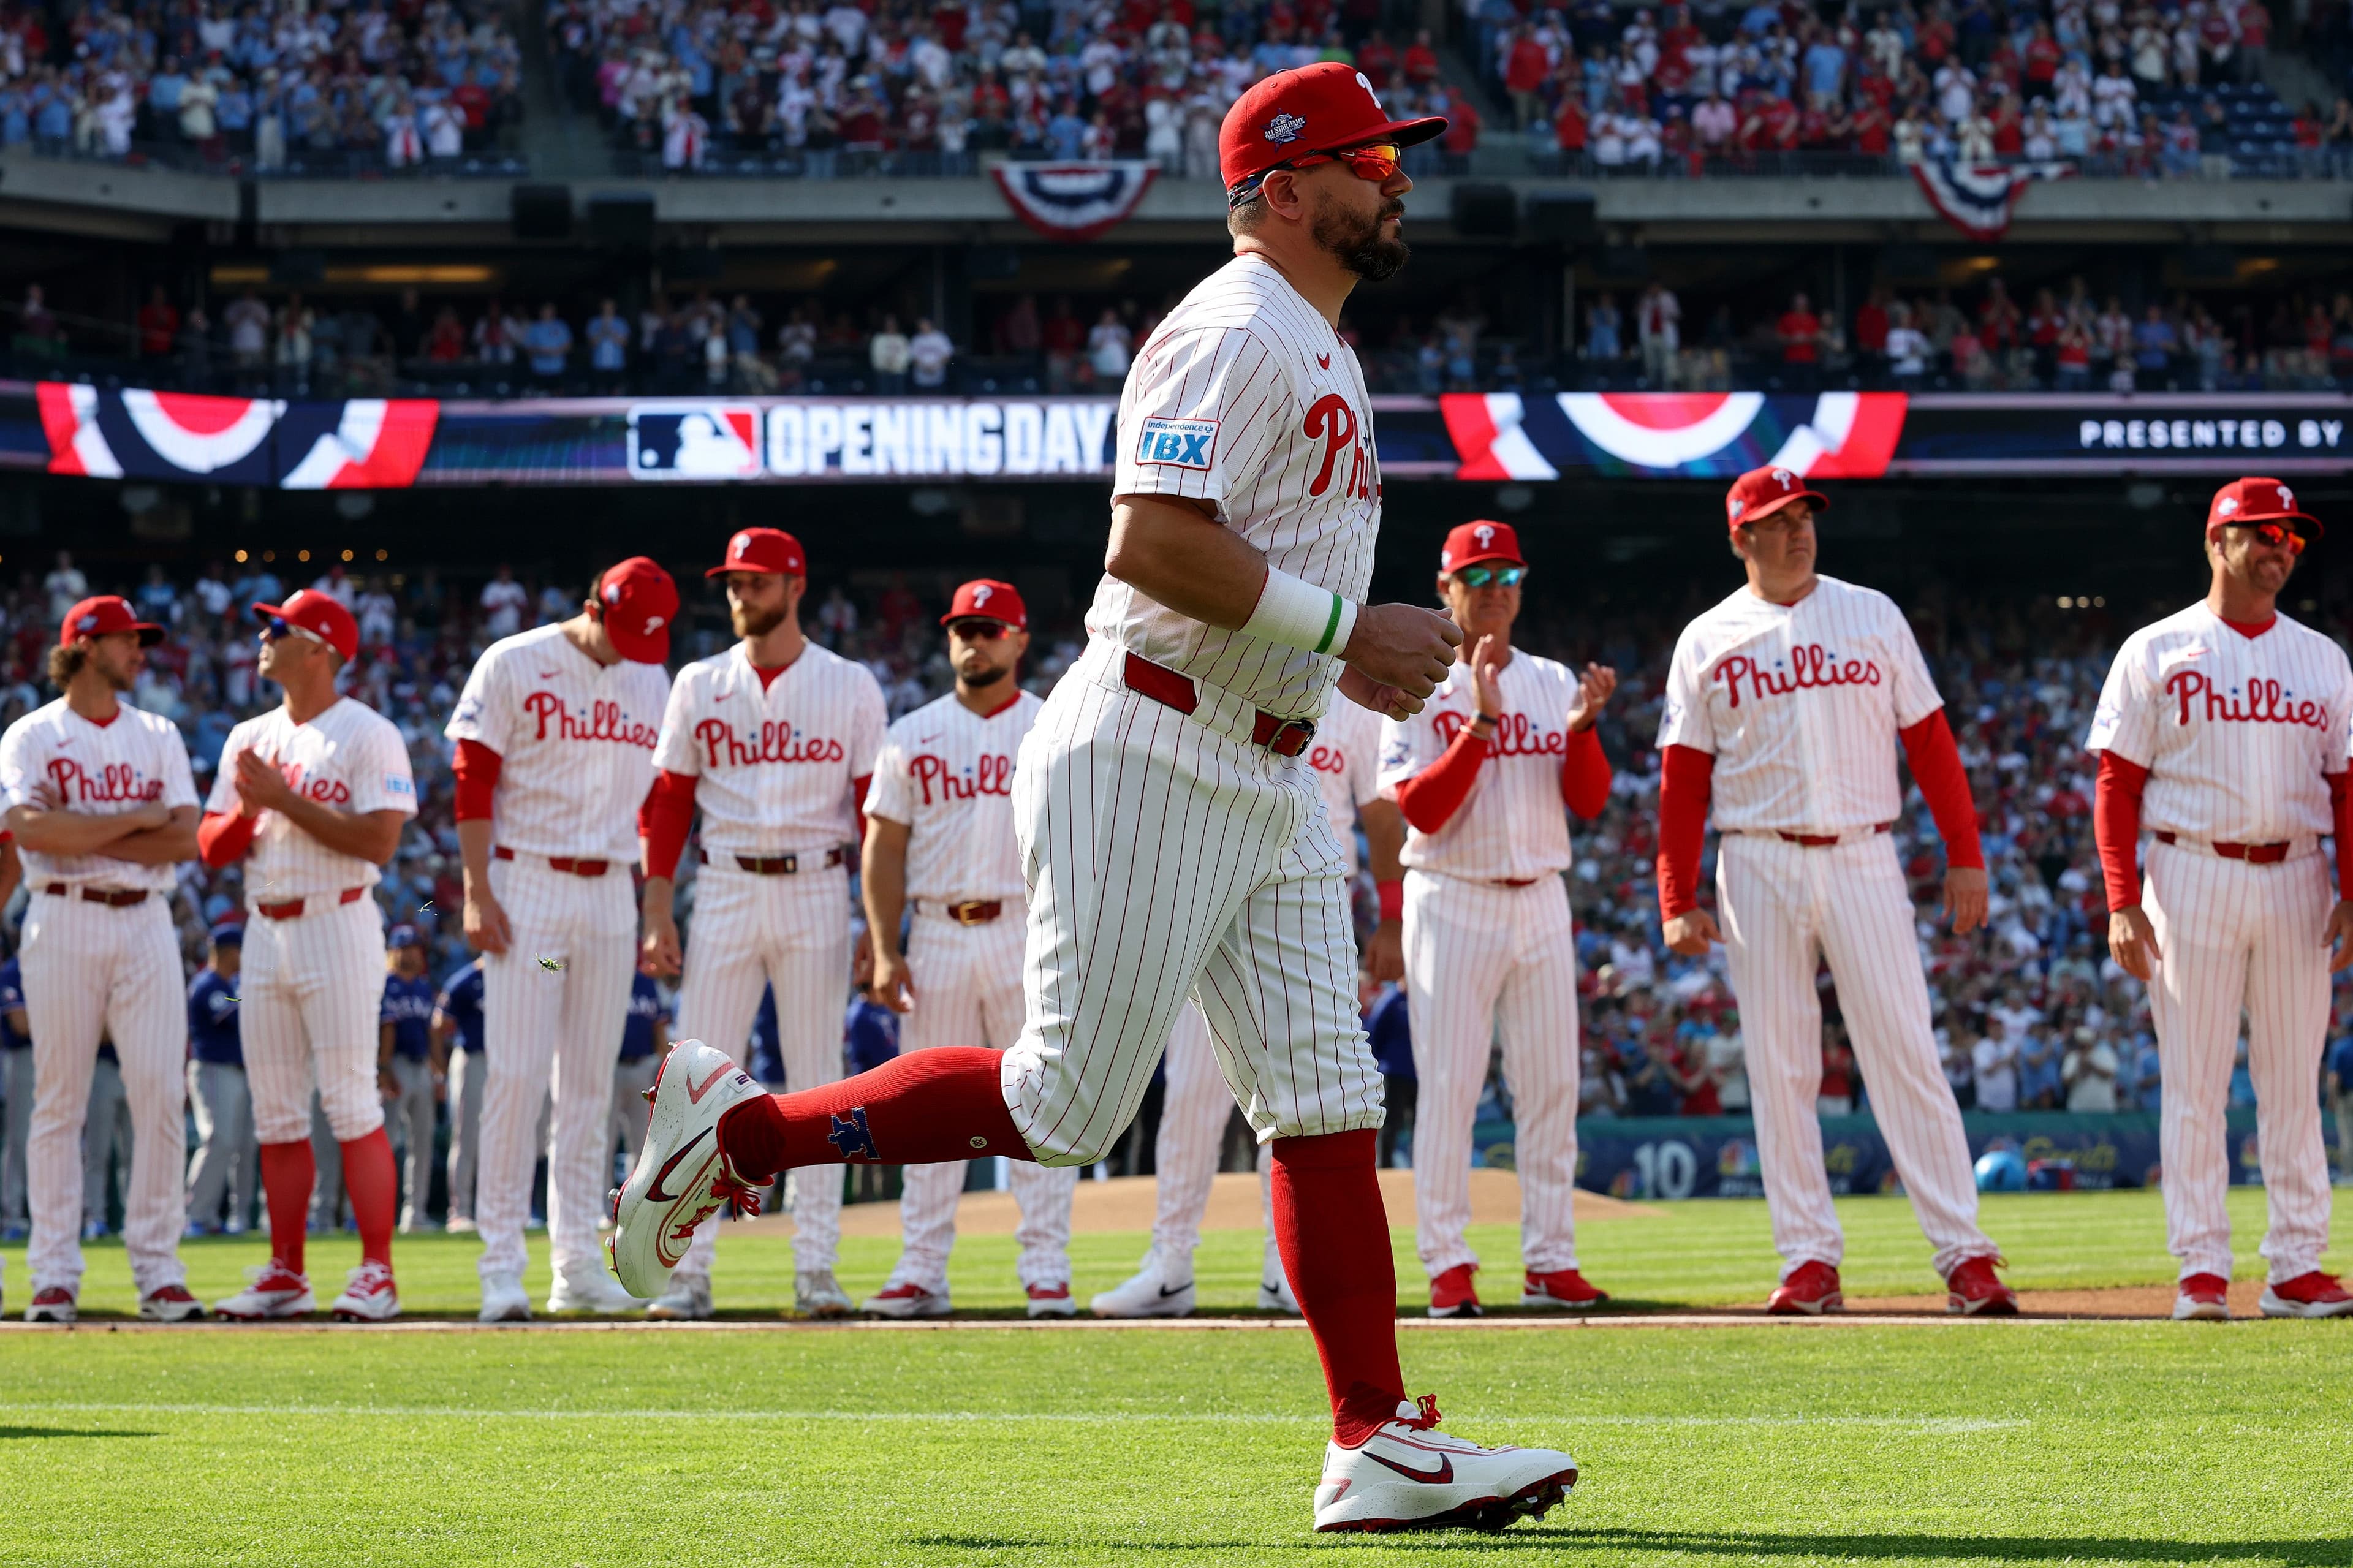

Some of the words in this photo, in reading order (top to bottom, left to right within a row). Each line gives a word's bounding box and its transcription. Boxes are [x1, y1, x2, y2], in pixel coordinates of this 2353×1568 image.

[1140, 431, 1211, 466] IBX
[1148, 421, 1203, 431] Independence
[2080, 420, 2286, 448] PRESENTED
[2298, 420, 2343, 447] BY
[1715, 643, 1881, 708] Phillies
[2166, 670, 2328, 732] Phillies
[525, 690, 658, 751] Phillies
[695, 718, 844, 768] Phillies
[1433, 711, 1566, 759] Pllie
[909, 754, 1012, 806] Phill
[1634, 1140, 1699, 1200] 10
